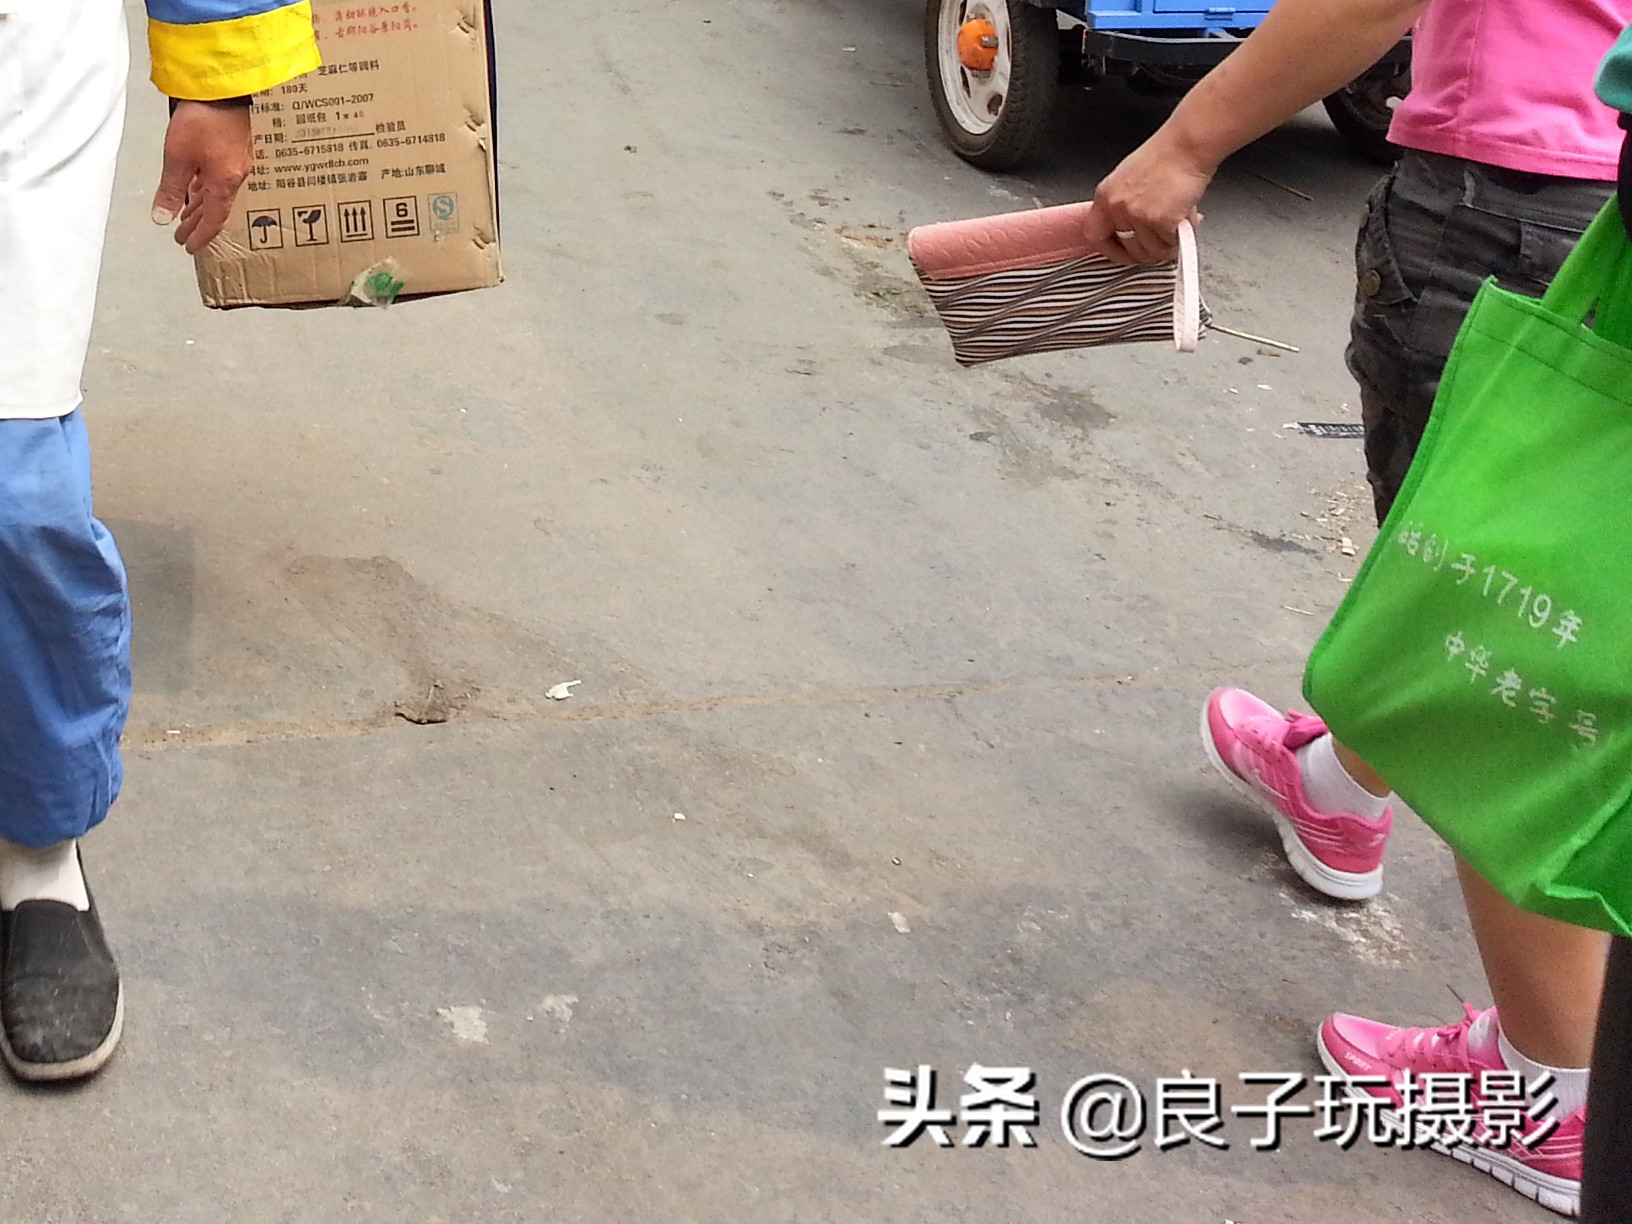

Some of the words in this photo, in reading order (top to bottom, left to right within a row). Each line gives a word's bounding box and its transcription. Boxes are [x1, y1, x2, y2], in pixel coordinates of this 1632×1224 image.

[318, 60, 380, 76] 芝麻仁等调料
[280, 83, 308, 95] 180天
[275, 143, 344, 158] 0635-6715818
[377, 133, 446, 148] 0635-6714818
[395, 202, 408, 217] 6
[1445, 631, 1598, 744] 中华老字号
